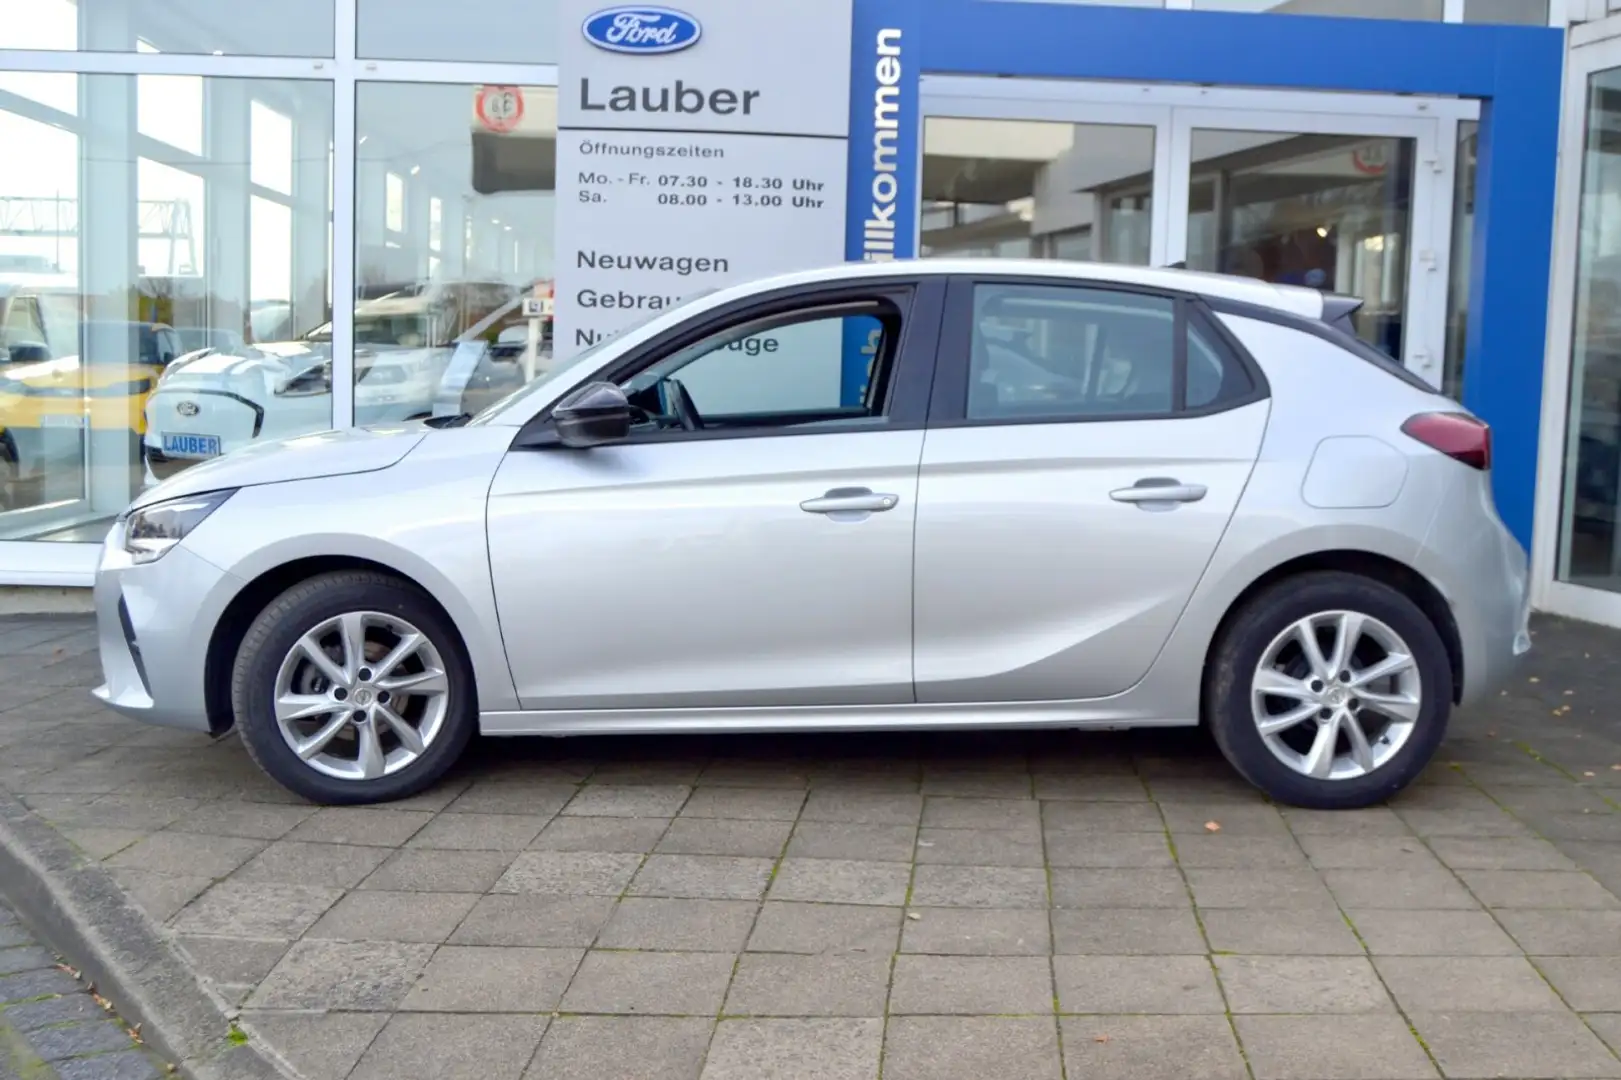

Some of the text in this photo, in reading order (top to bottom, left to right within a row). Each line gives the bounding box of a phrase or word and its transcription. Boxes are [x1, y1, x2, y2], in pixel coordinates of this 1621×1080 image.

[605, 13, 679, 44] Ford
[580, 77, 761, 115] Lauber
[579, 139, 724, 159] Öffnungszeiten
[864, 28, 902, 262] illkommen
[578, 172, 613, 185] Mo.
[628, 172, 651, 186] Fr.
[657, 174, 708, 188] 07.30
[733, 176, 783, 190] 18.30
[792, 178, 825, 192] Uhr
[579, 190, 607, 203] Sa.
[657, 193, 708, 206] 08.00
[791, 196, 824, 209] Uhr
[577, 250, 729, 276] Neuwagen
[163, 435, 218, 455] LAUBER
